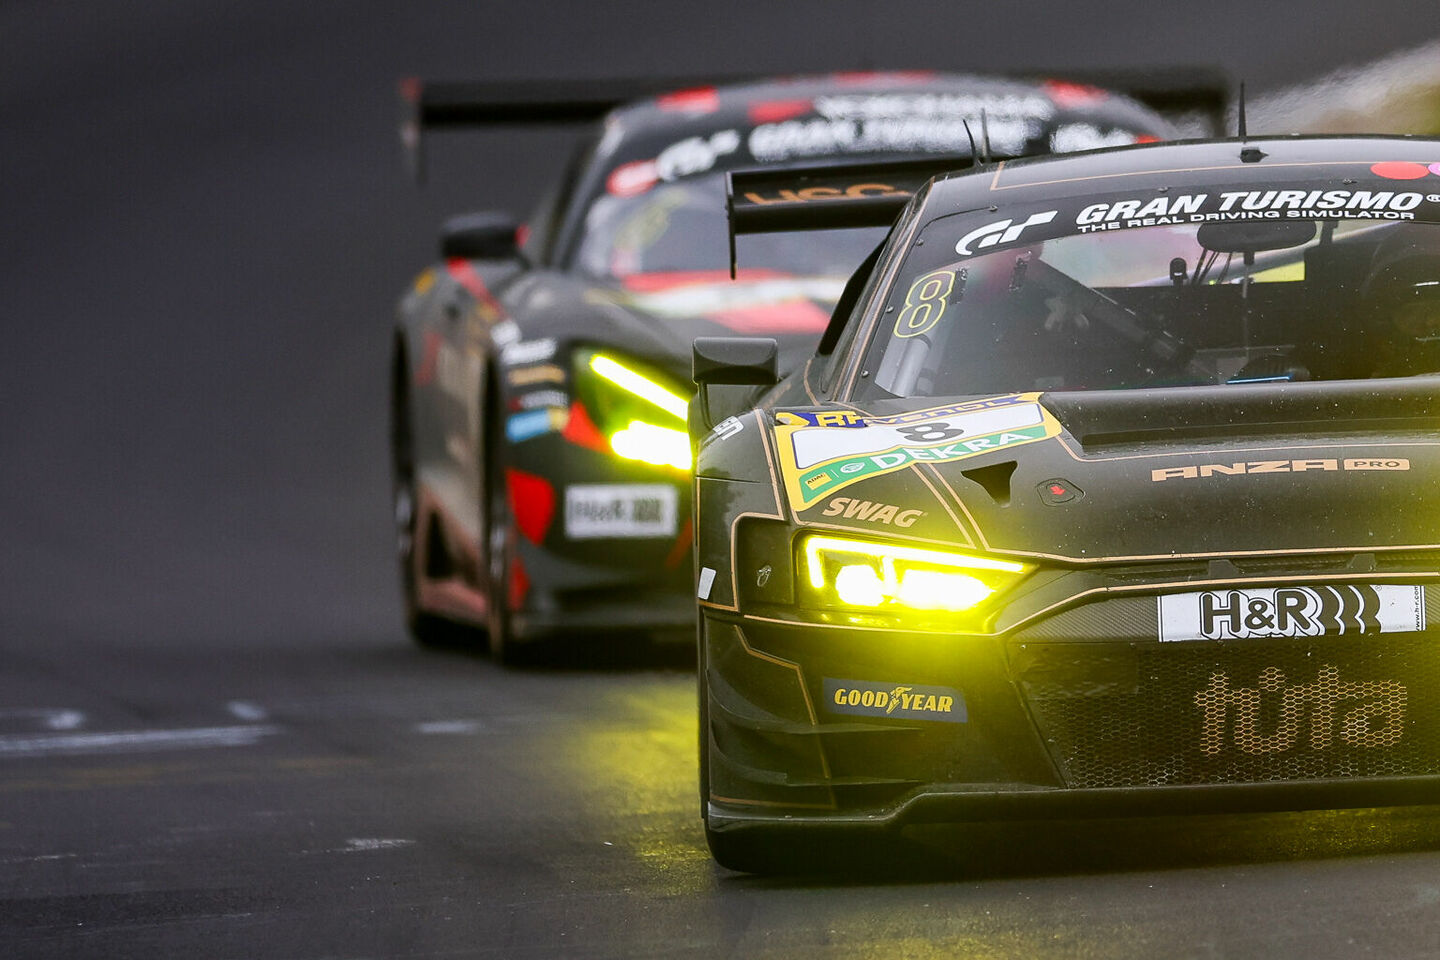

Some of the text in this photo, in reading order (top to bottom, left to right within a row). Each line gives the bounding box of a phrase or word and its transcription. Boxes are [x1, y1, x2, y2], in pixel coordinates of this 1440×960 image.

[1076, 193, 1207, 226] GRAN
[1077, 210, 1415, 233] THE REAL DRIVING SIMULATOR
[893, 270, 956, 339] 8
[896, 422, 965, 442] 8
[870, 432, 1034, 470] DEKRA
[1151, 459, 1401, 482] ANZA PRO
[822, 497, 923, 528] SWAG
[1202, 589, 1313, 634] H&R
